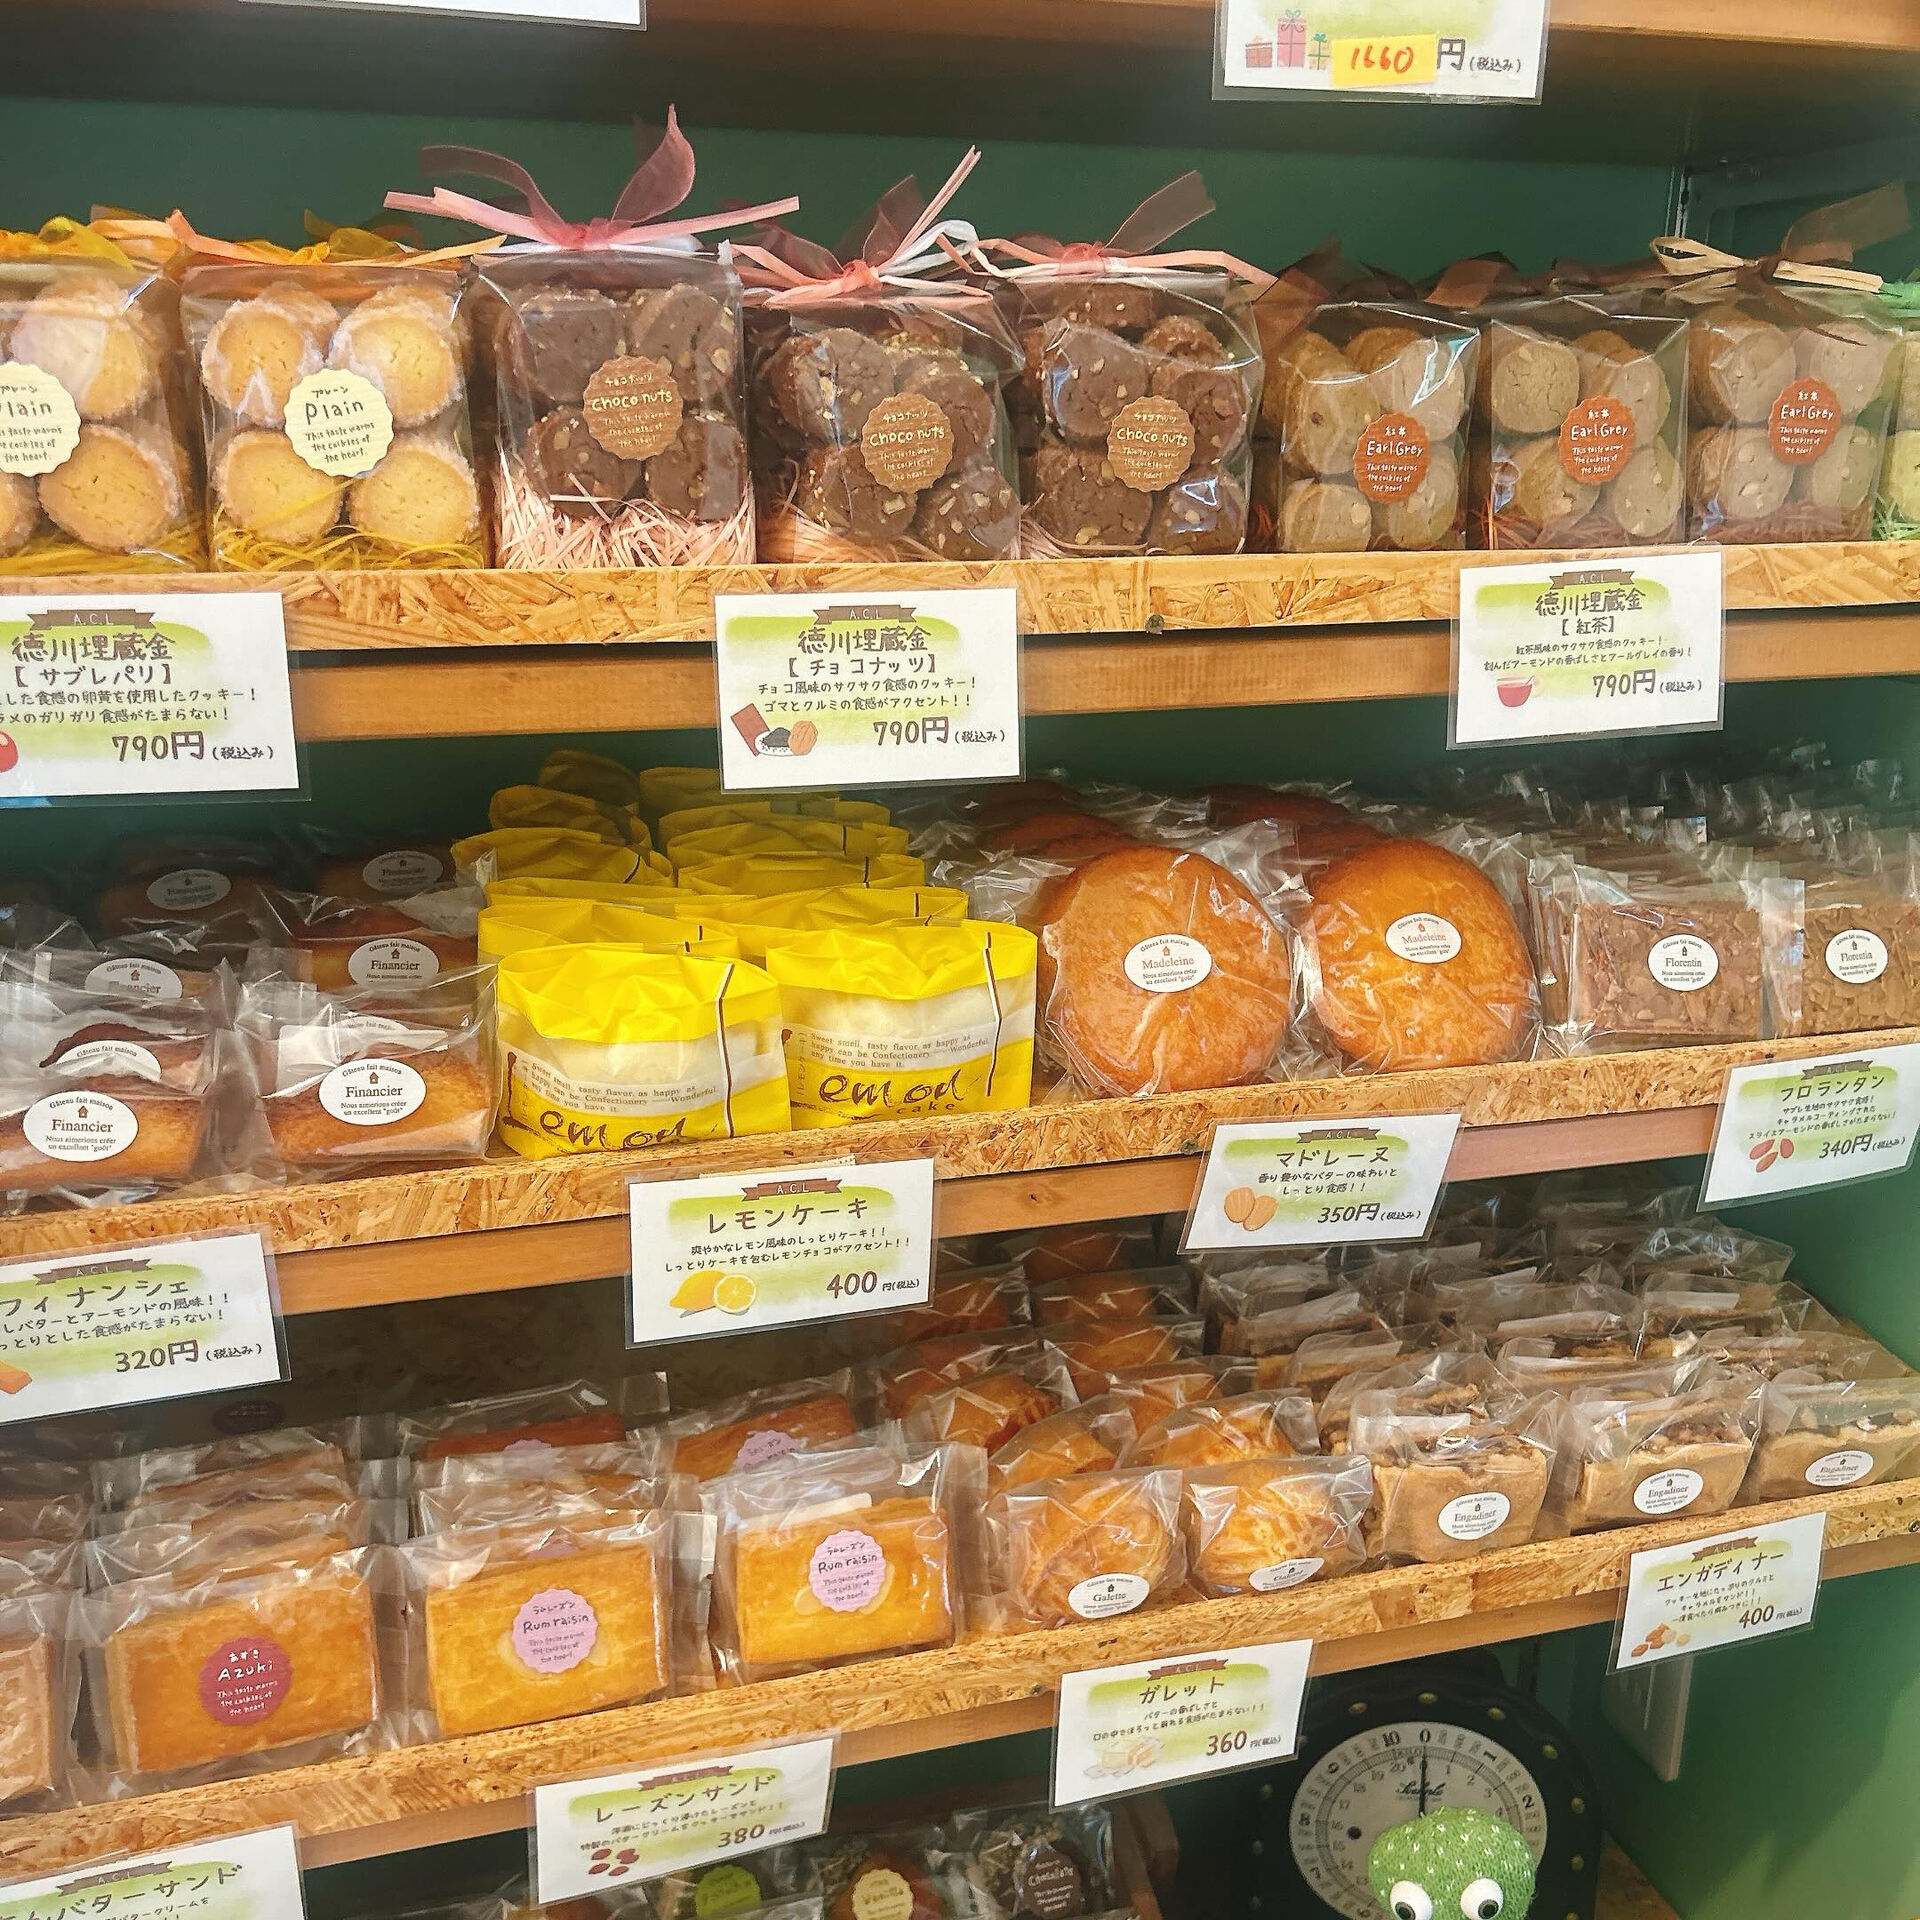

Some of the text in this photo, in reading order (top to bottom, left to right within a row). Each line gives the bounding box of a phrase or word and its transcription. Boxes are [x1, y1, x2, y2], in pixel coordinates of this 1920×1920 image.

[1351, 45, 1413, 74] 1660
[1439, 38, 1465, 70] 円
[0, 401, 52, 417] lain
[1535, 588, 1645, 616] 徳川埋蔵金
[1561, 615, 1615, 636] 【紅茶】
[12, 631, 176, 663] 徳川埋蔵金
[798, 625, 931, 654] 徳川埋蔵金
[14, 664, 171, 688] 【サブレパリ】
[788, 653, 936, 678] 【チョコナッツ】
[1593, 668, 1657, 697] 790円
[0, 688, 257, 705] した食感の卵黄を使用したクッキー！
[873, 716, 949, 746] 790円
[112, 730, 204, 762] 790円
[1402, 933, 1446, 944] Madeleine
[371, 960, 420, 970] Financier
[1142, 957, 1195, 969] Madeleine
[1665, 958, 1702, 967] Florentin
[345, 1086, 403, 1097] Financier
[1781, 1075, 1885, 1102] フロランタン
[896, 1102, 956, 1114] cake
[51, 1119, 113, 1133] Financier
[1276, 1146, 1389, 1169] マドレーヌ
[1819, 1133, 1873, 1159] 340円
[708, 1197, 869, 1235] レモンケーキ
[1318, 1202, 1380, 1224] 350円
[826, 1270, 878, 1299] 400
[0, 1280, 189, 1317] フィナンシェ
[114, 1339, 198, 1373] 320円
[1657, 1552, 1784, 1593] エンガディナー
[1739, 1604, 1775, 1629] 400
[218, 1661, 273, 1681] Azuki
[1139, 1676, 1225, 1705] ガレット
[1205, 1730, 1247, 1757] 360
[596, 1773, 776, 1823] レーズンサンド
[718, 1823, 765, 1849] 380
[0, 1864, 243, 1920] バターサンド
